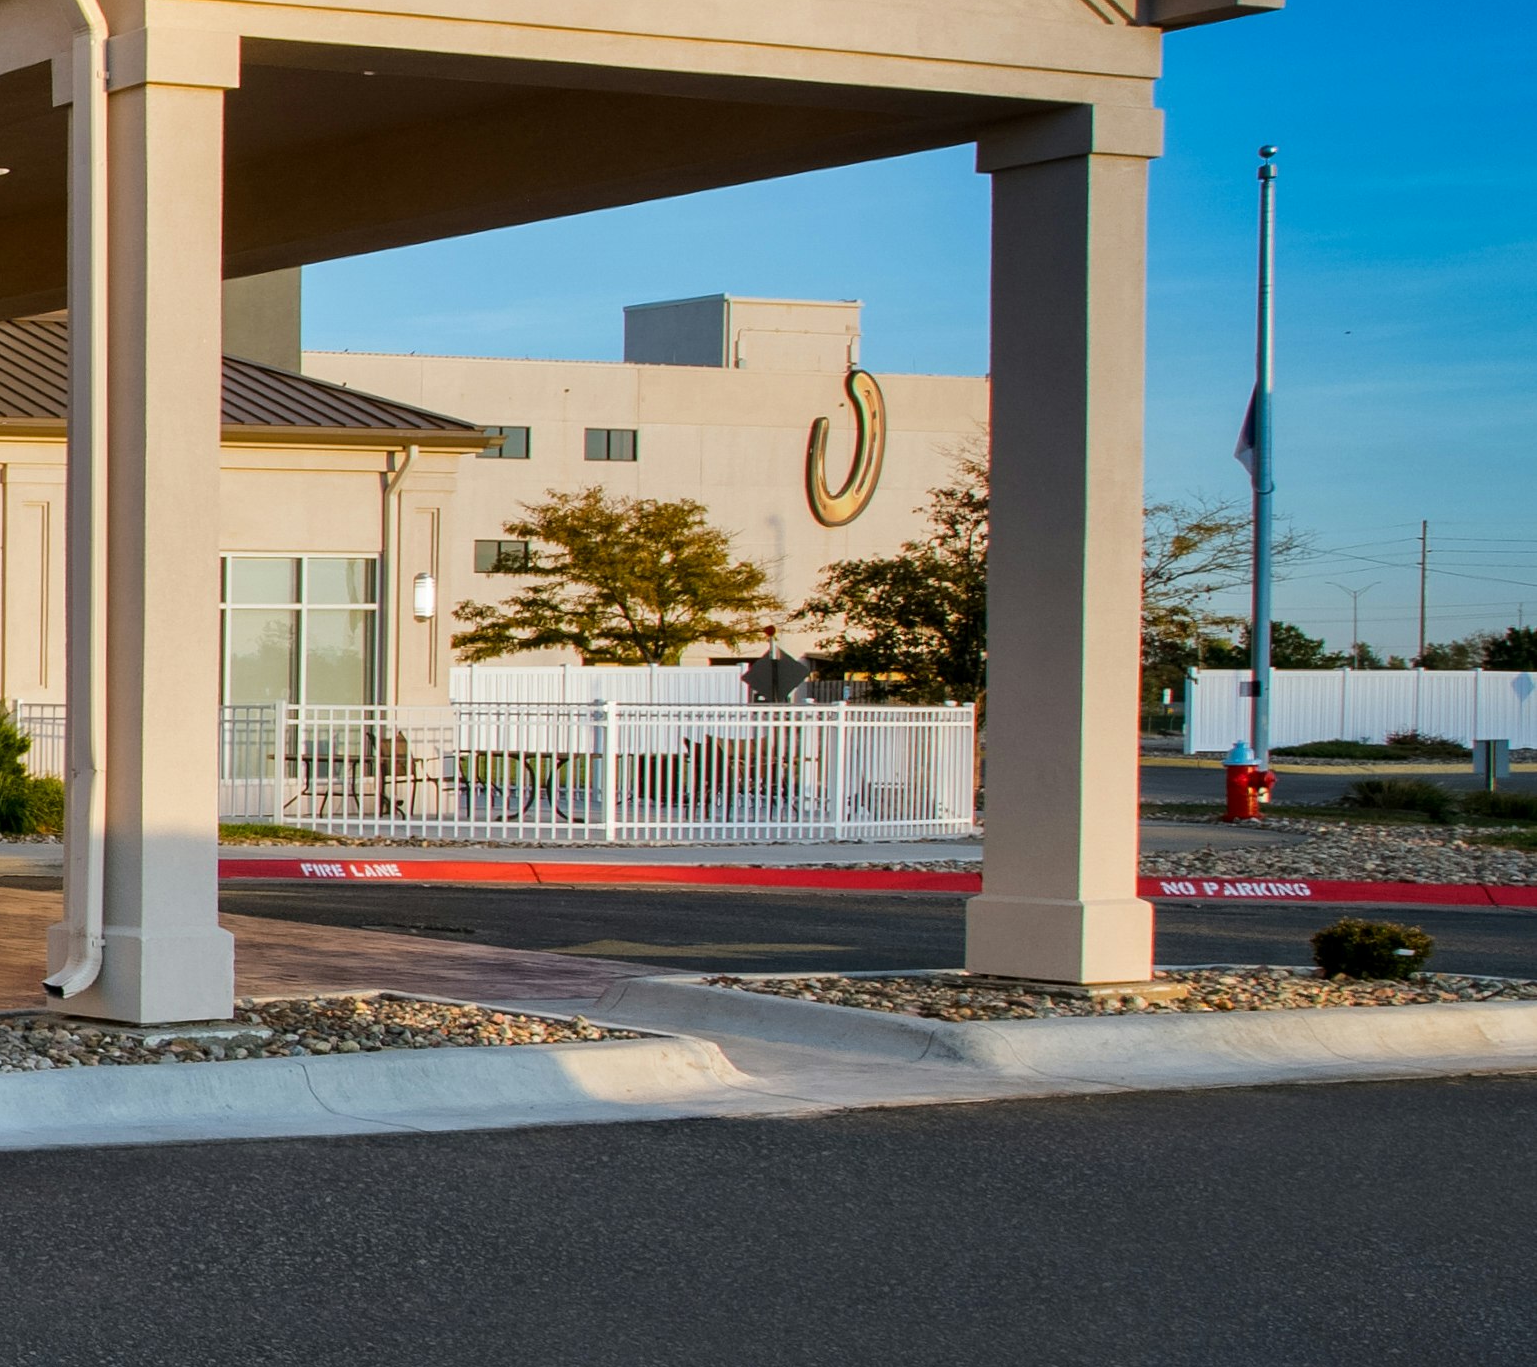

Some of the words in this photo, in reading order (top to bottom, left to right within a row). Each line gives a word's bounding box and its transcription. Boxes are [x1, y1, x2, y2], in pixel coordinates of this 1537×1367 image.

[300, 863, 346, 877] FIRE
[349, 864, 402, 877] LANE
[1160, 881, 1196, 895] NO
[1202, 882, 1311, 896] PARKING
